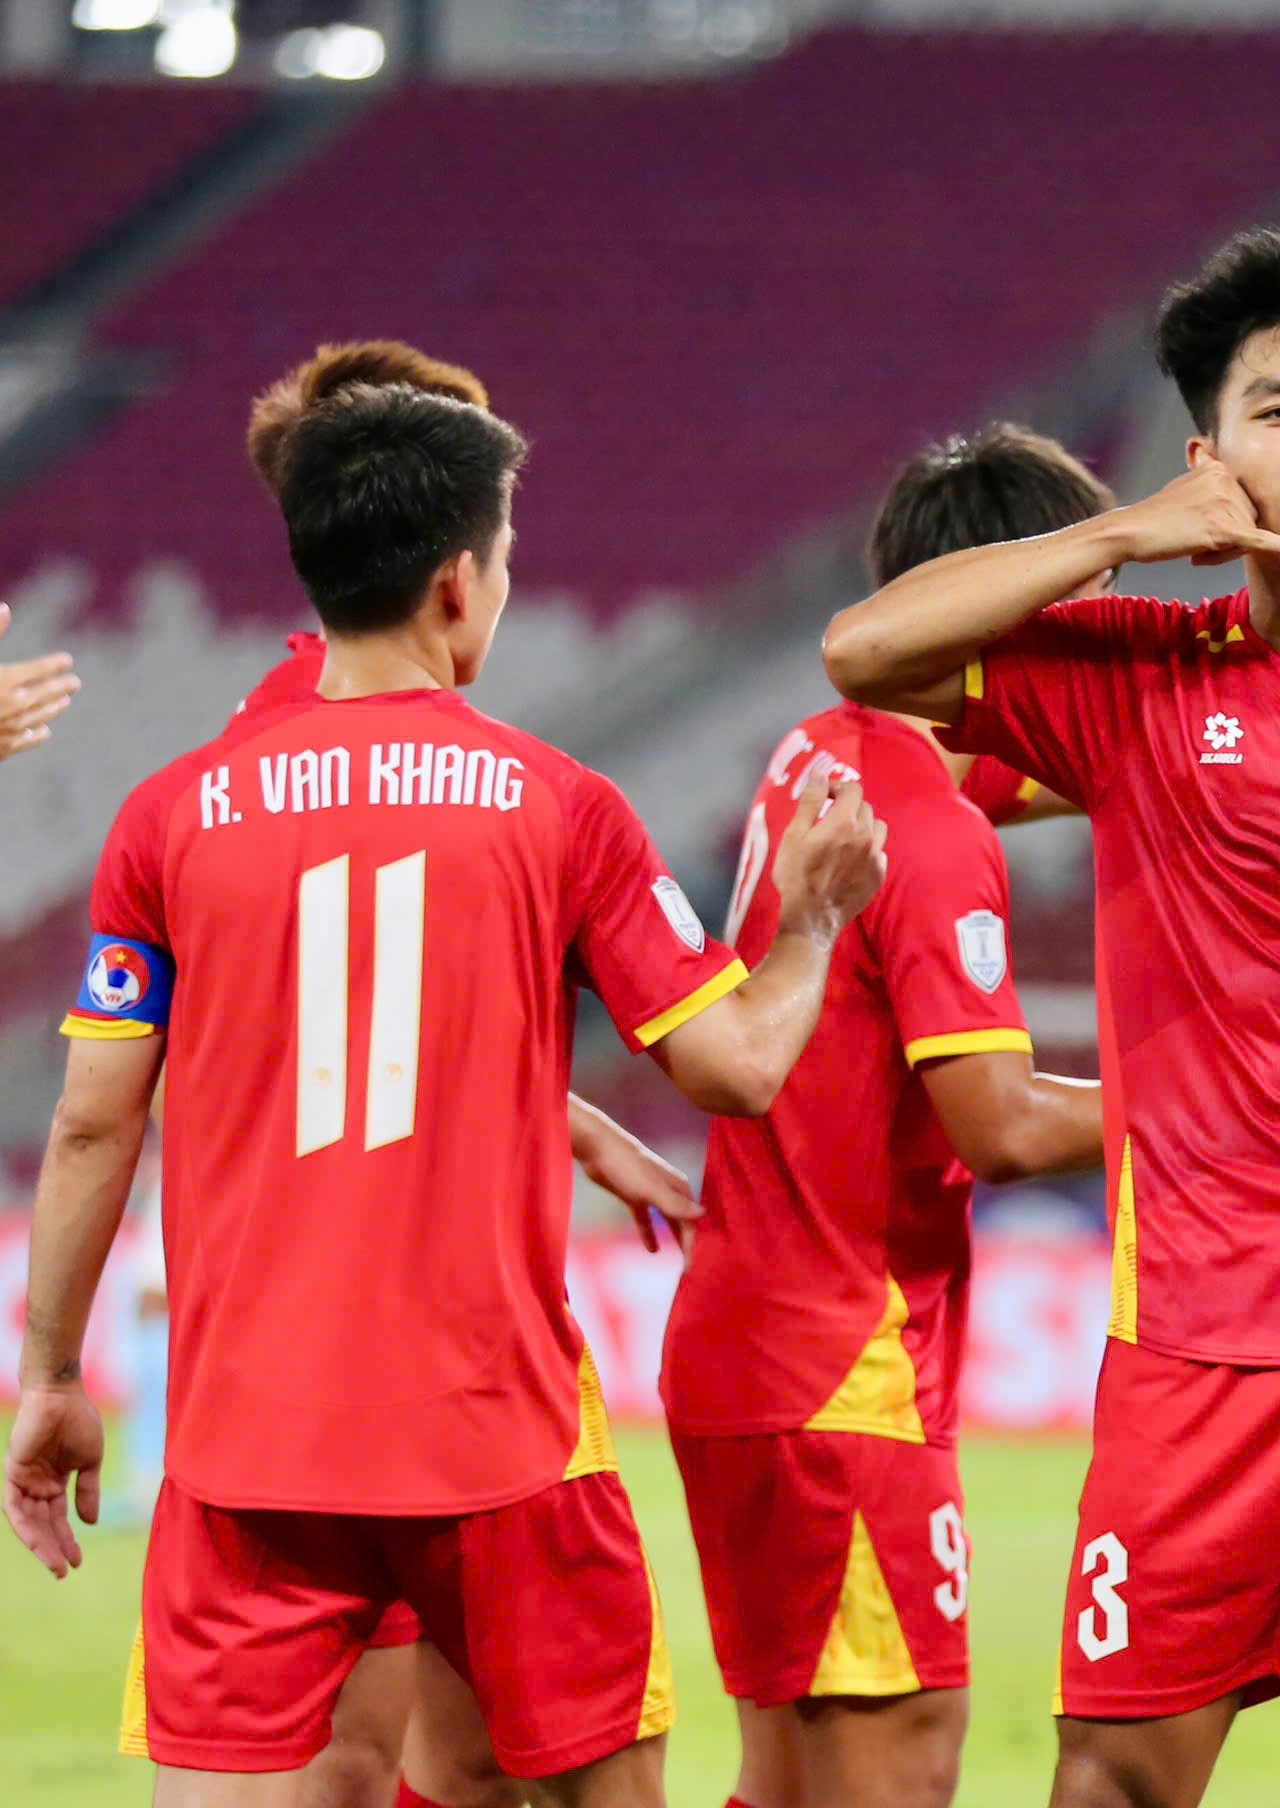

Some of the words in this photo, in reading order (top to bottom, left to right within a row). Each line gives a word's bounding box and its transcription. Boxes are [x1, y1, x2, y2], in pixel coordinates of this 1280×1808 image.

[200, 765, 243, 829] K.
[258, 745, 351, 814] VAN
[367, 742, 526, 812] KHANG
[296, 848, 426, 1159] 11
[929, 1501, 968, 1622] 9
[1076, 1530, 1129, 1662] 3
